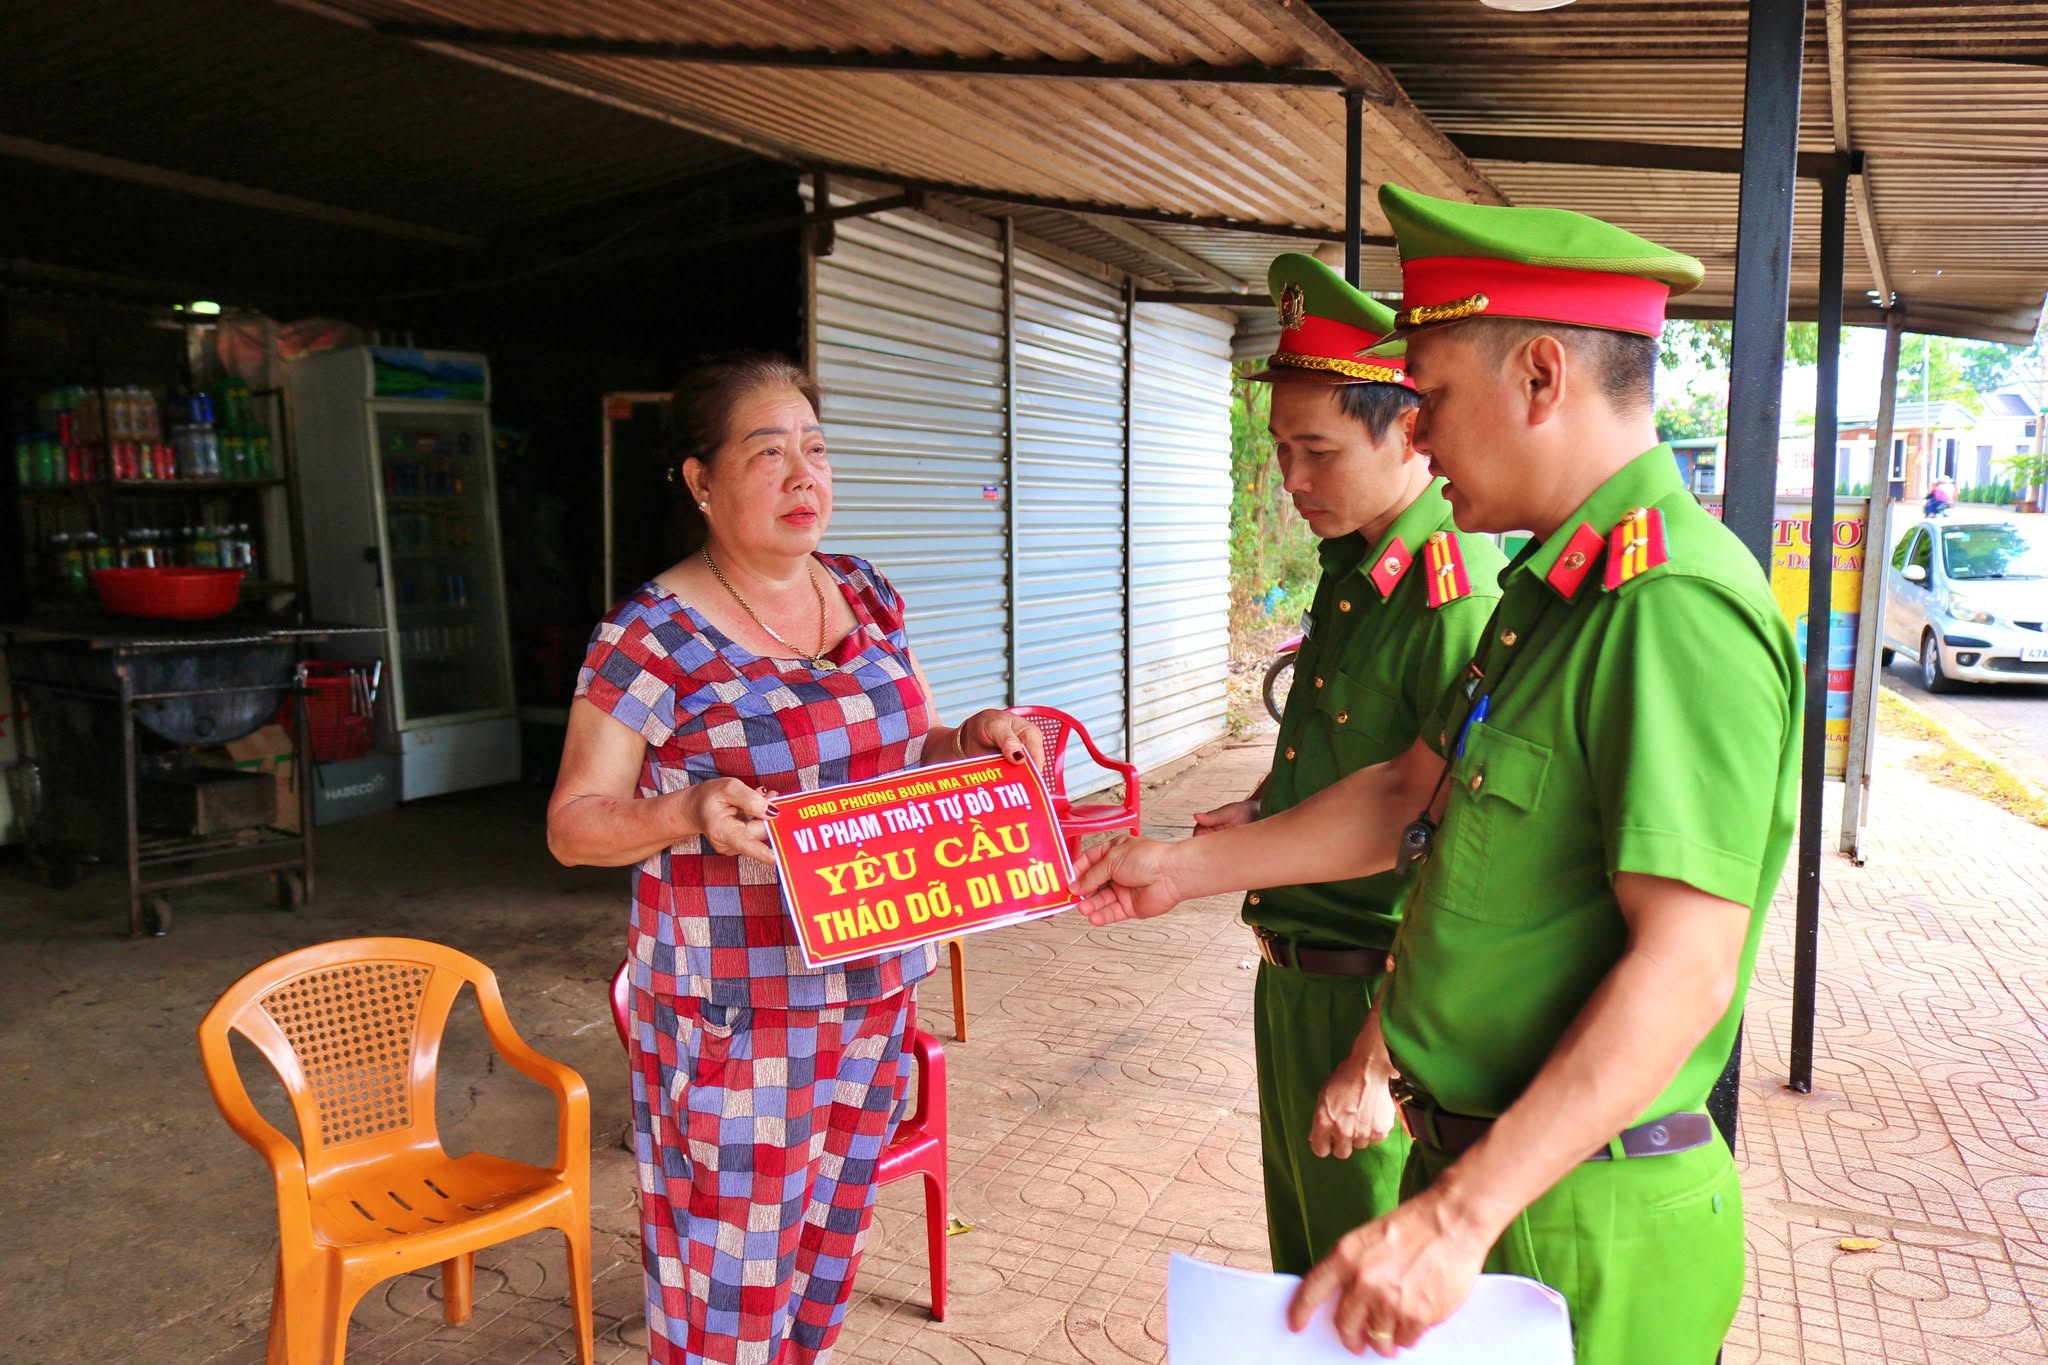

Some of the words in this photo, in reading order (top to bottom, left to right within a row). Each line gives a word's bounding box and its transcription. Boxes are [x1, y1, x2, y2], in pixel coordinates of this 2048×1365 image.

[793, 827, 819, 854] VI
[818, 812, 883, 848] PHẠM
[882, 800, 935, 834] TRẬT
[935, 793, 964, 825] TỰ
[963, 786, 995, 816] ĐÔ
[993, 781, 1032, 811] THỊ
[798, 800, 838, 820] UBND
[840, 789, 897, 811] PHƯỜNG
[898, 780, 937, 799] BUÔN
[939, 777, 961, 791] MA
[961, 767, 1004, 787] THUỘT
[815, 849, 917, 896] YÊU
[934, 818, 1031, 868] CẦU
[813, 898, 900, 945] THÁO
[904, 879, 964, 924] DỠ,
[966, 873, 1003, 909] DI
[1005, 858, 1061, 900] DỜI
